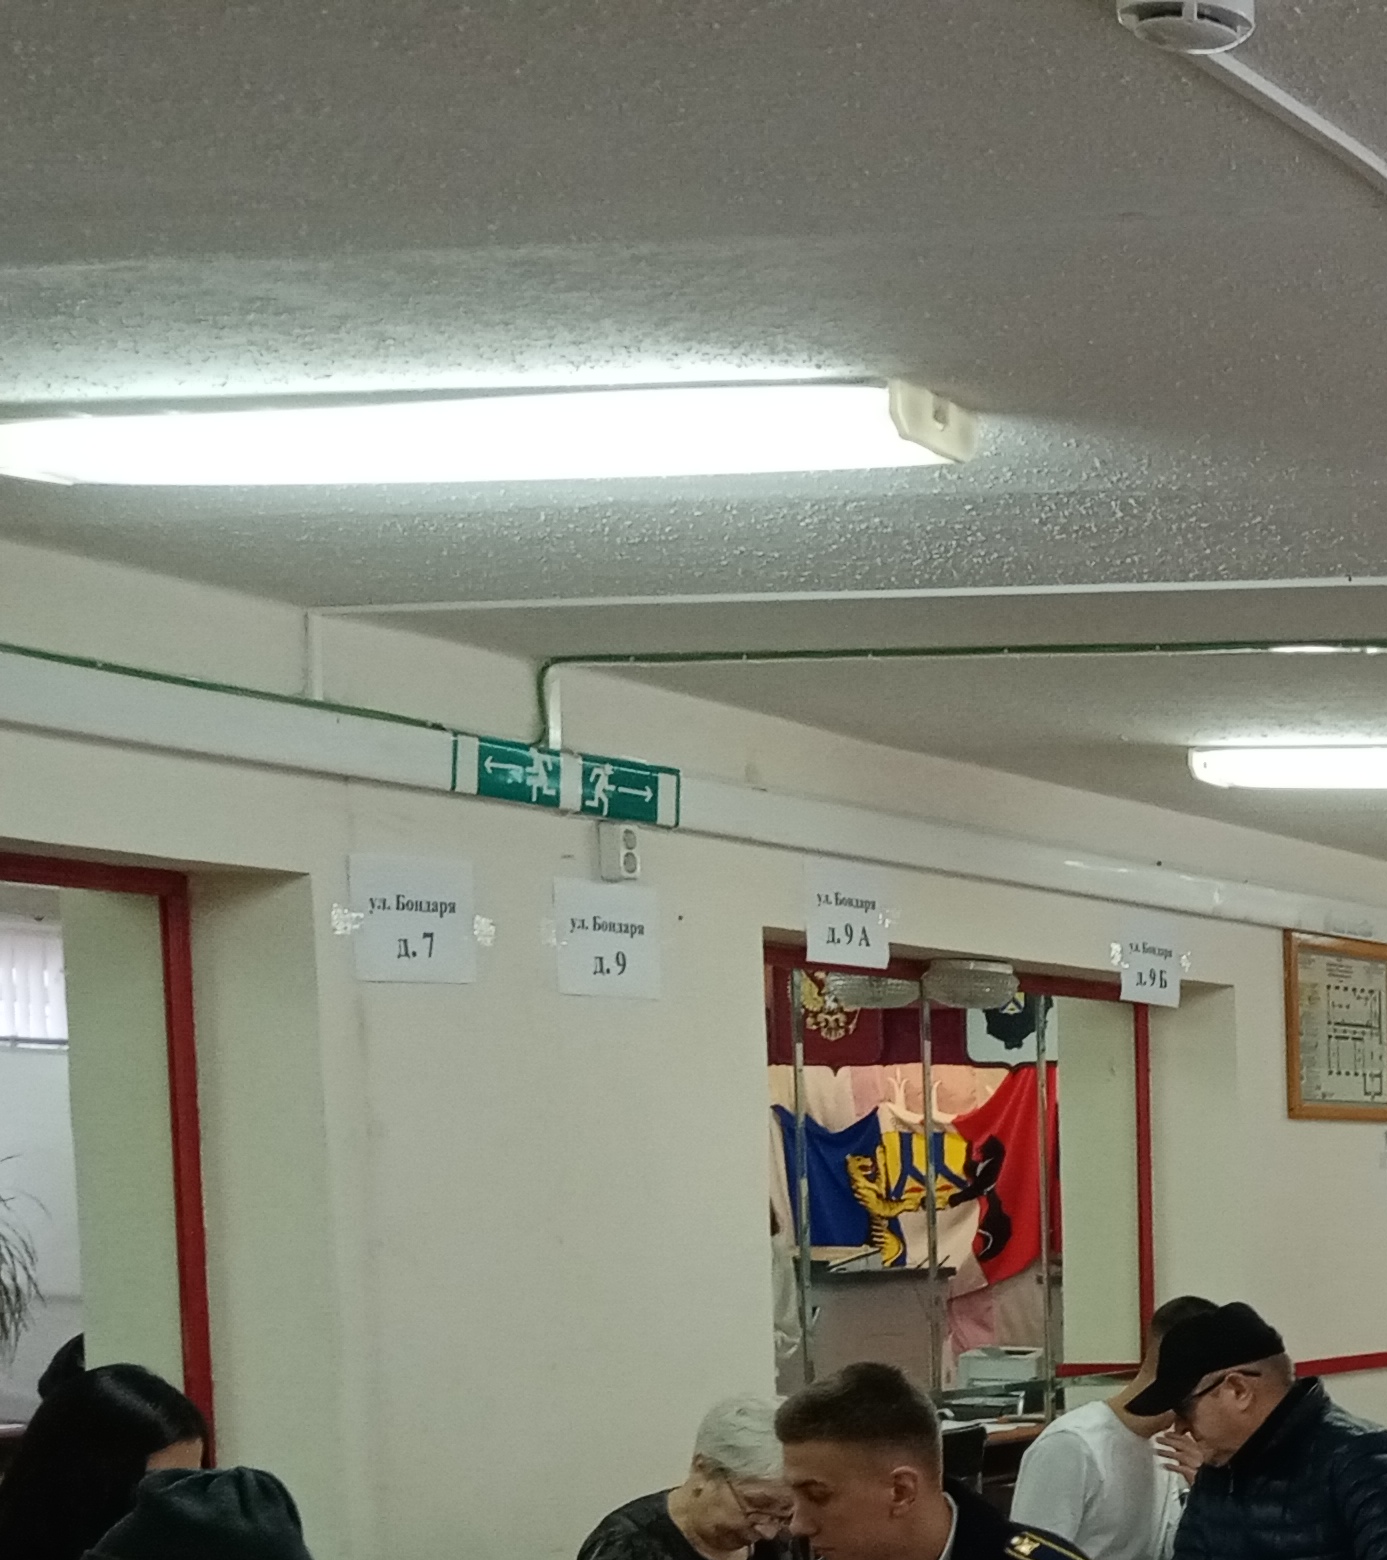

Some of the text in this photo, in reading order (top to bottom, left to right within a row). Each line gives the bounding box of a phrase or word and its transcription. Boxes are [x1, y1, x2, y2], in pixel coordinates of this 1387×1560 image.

[368, 893, 457, 918] ул. Бондаря
[569, 915, 645, 939] ул. Бондаря
[844, 922, 854, 945] 9
[858, 925, 871, 947] А
[396, 931, 435, 959] д. 7
[592, 950, 627, 976] д. 9
[1149, 967, 1157, 987] 9
[1159, 969, 1168, 989] Б
